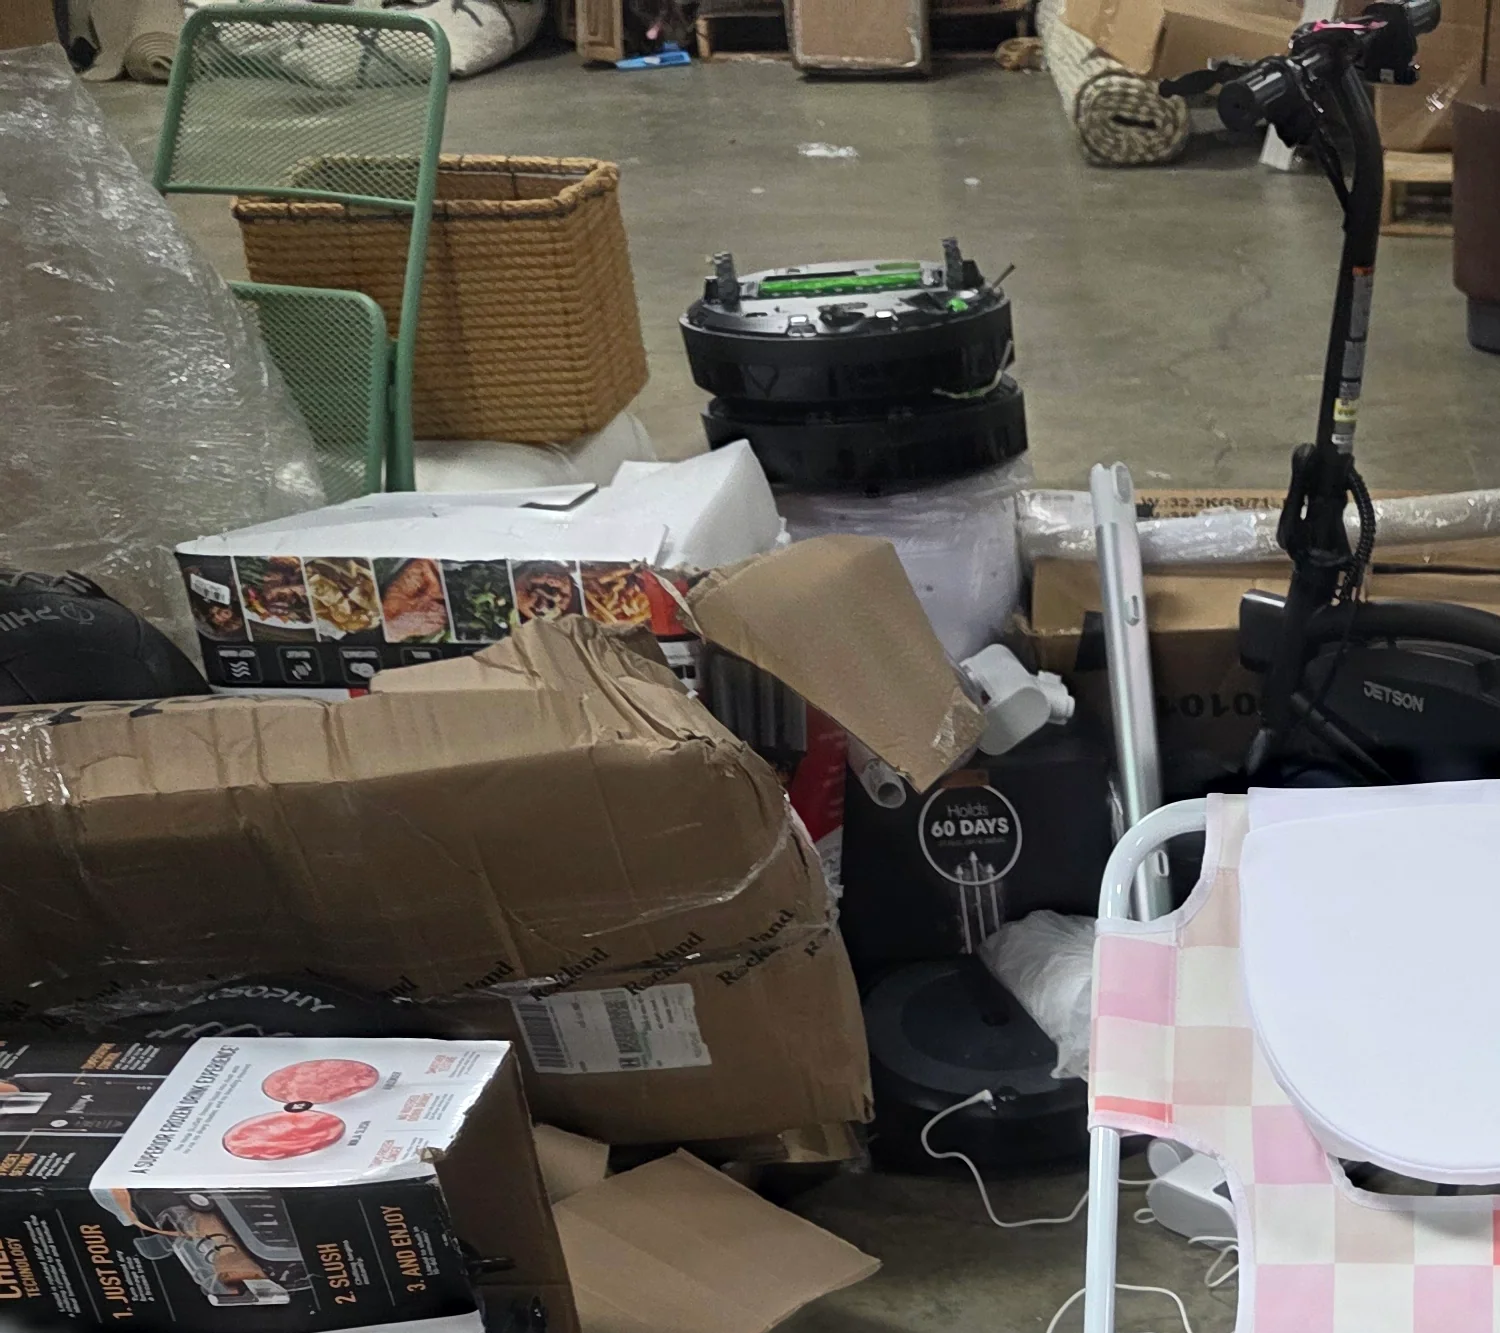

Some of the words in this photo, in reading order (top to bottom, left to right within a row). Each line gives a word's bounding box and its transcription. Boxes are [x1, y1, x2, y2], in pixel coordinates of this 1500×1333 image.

[1364, 680, 1425, 713] JETSON
[931, 820, 956, 837] 60
[960, 817, 1009, 836] DAYS
[134, 1133, 173, 1167] SUPERIOR
[160, 1105, 195, 1132] FROZEN
[380, 1205, 413, 1247] ENJOY
[80, 1224, 110, 1264] POUR
[5, 1237, 41, 1297] TECHNOLOGY
[316, 1243, 350, 1289] SLUSH
[396, 1250, 423, 1277] AND
[99, 1275, 129, 1304] JUST
[335, 1290, 356, 1304] 2.
[407, 1280, 426, 1292] 3.
[112, 1307, 134, 1320] 1.
